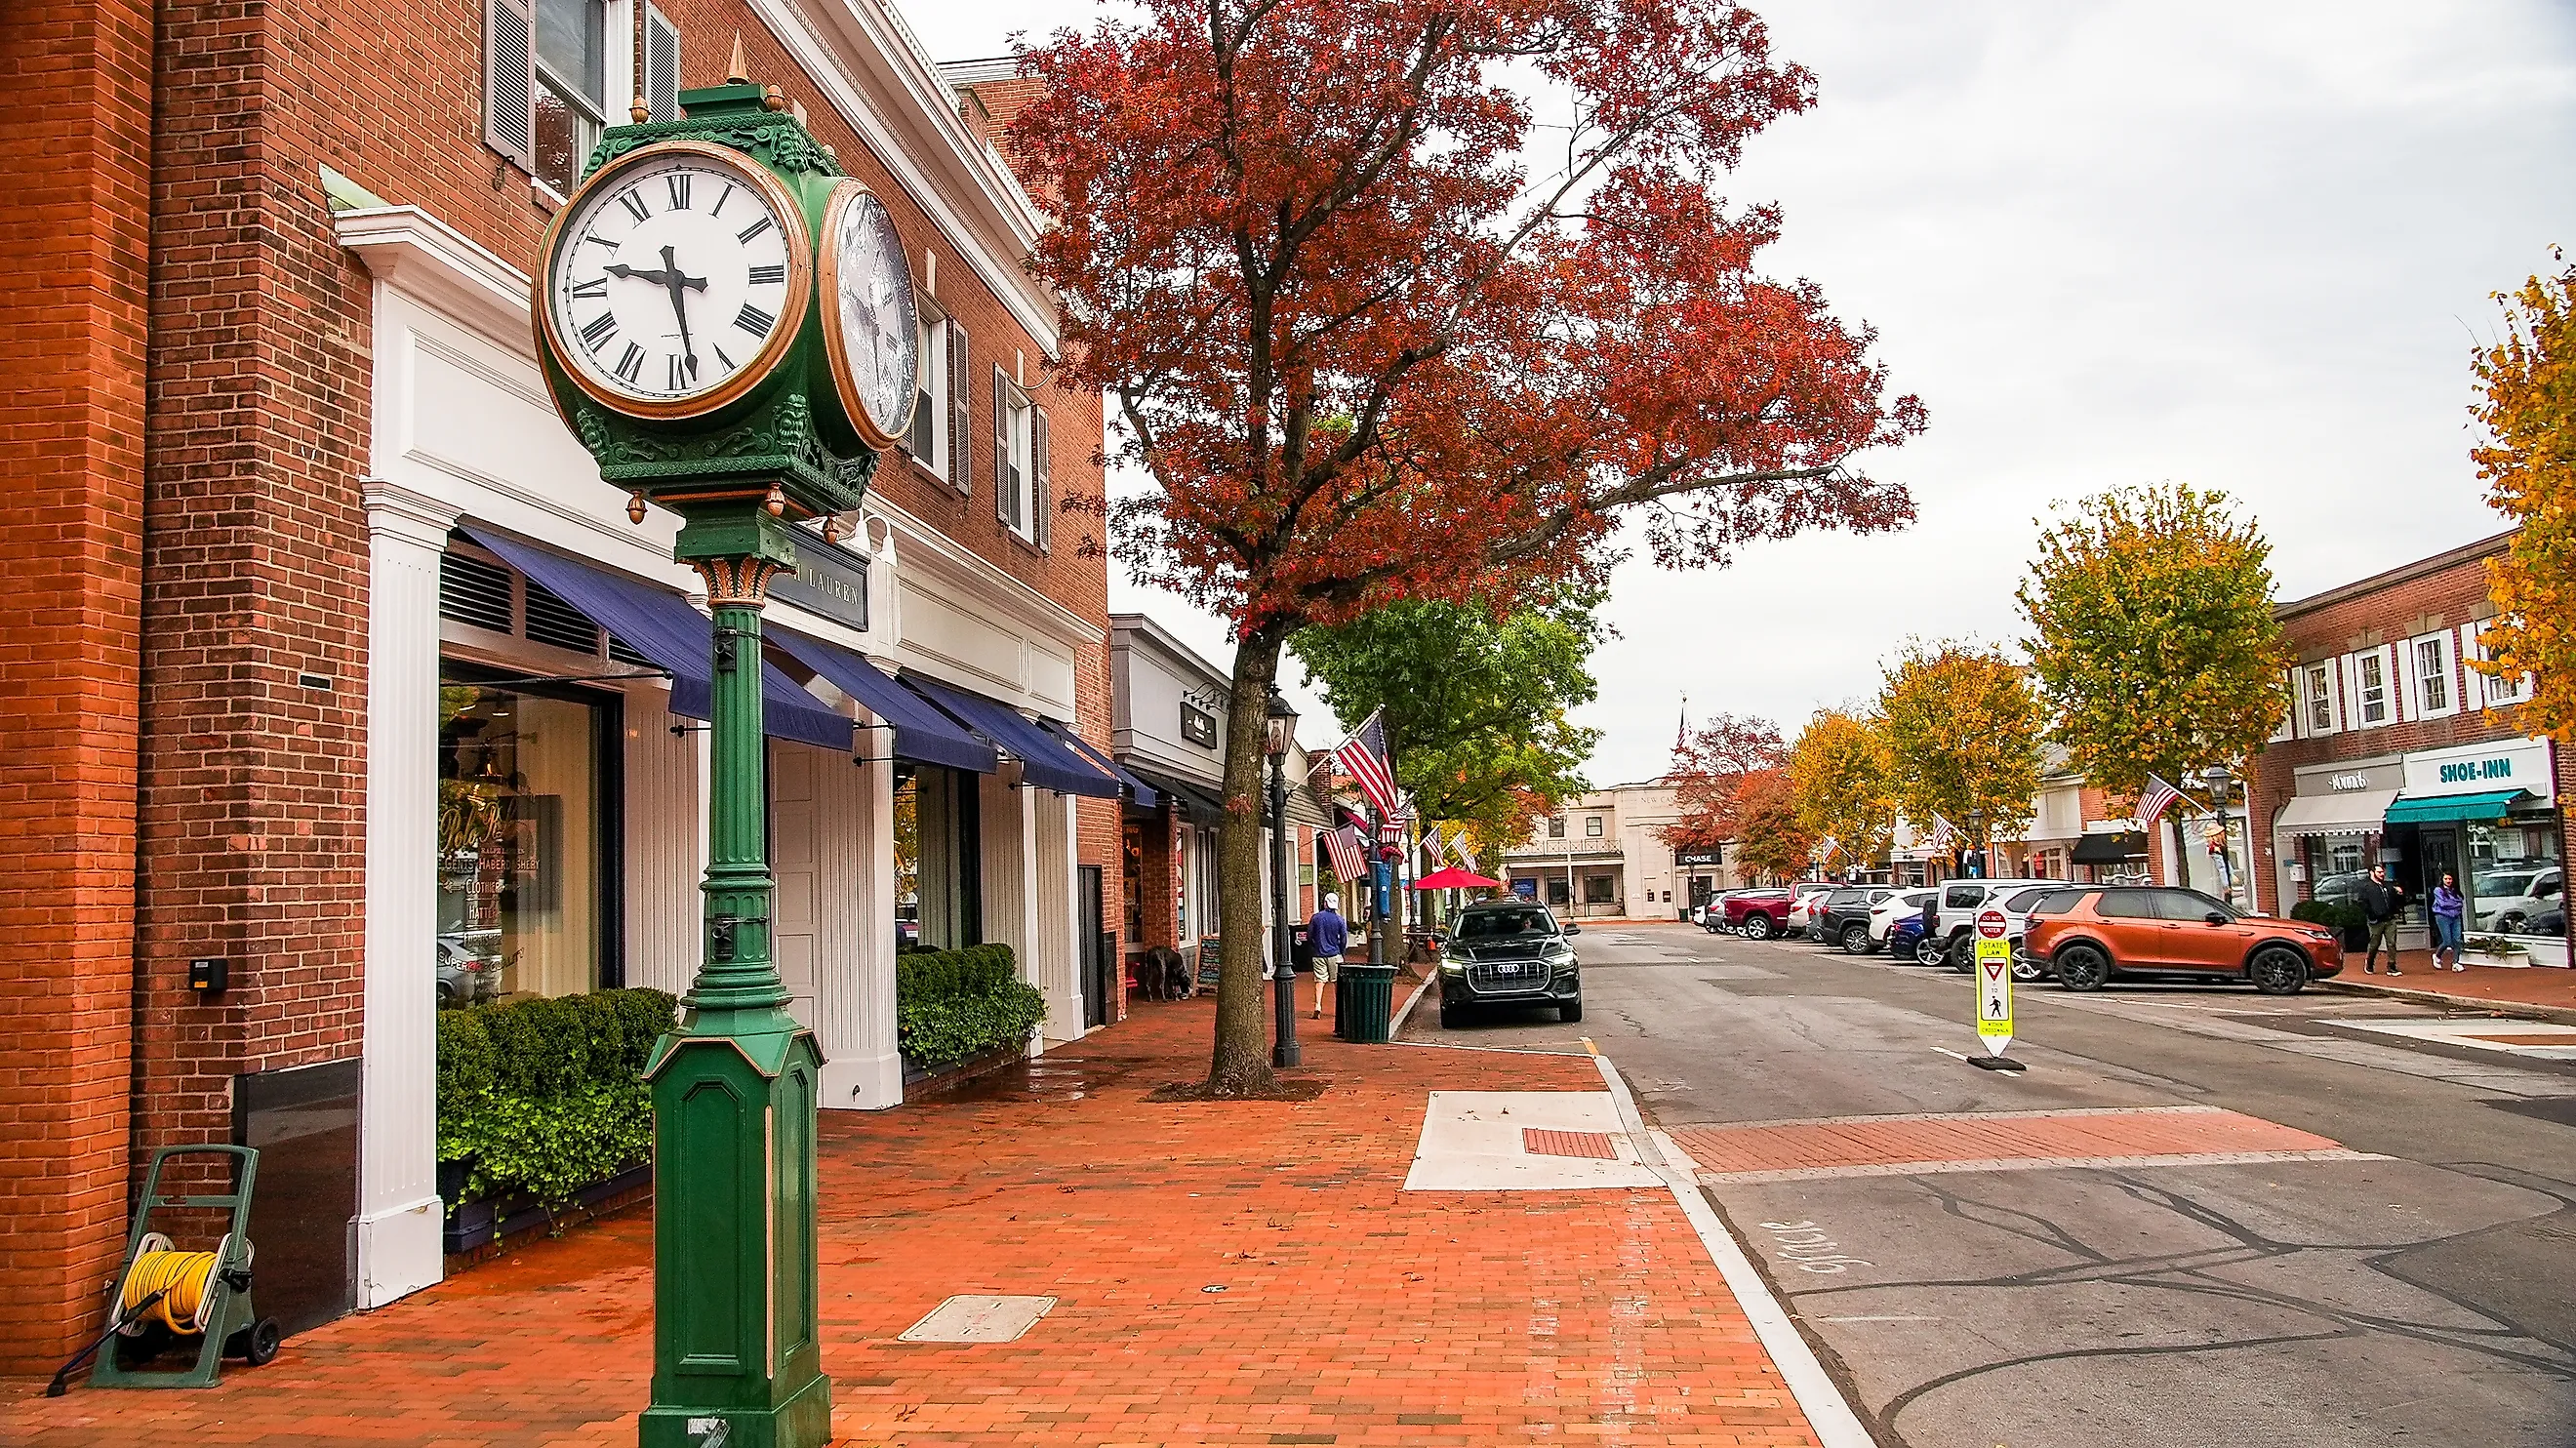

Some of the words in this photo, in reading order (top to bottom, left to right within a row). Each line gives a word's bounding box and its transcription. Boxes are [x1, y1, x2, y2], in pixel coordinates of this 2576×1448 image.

[809, 568, 858, 605] LAUREN
[2439, 758, 2511, 783] SHOE-INN
[478, 859, 541, 870] HABERDSHERY
